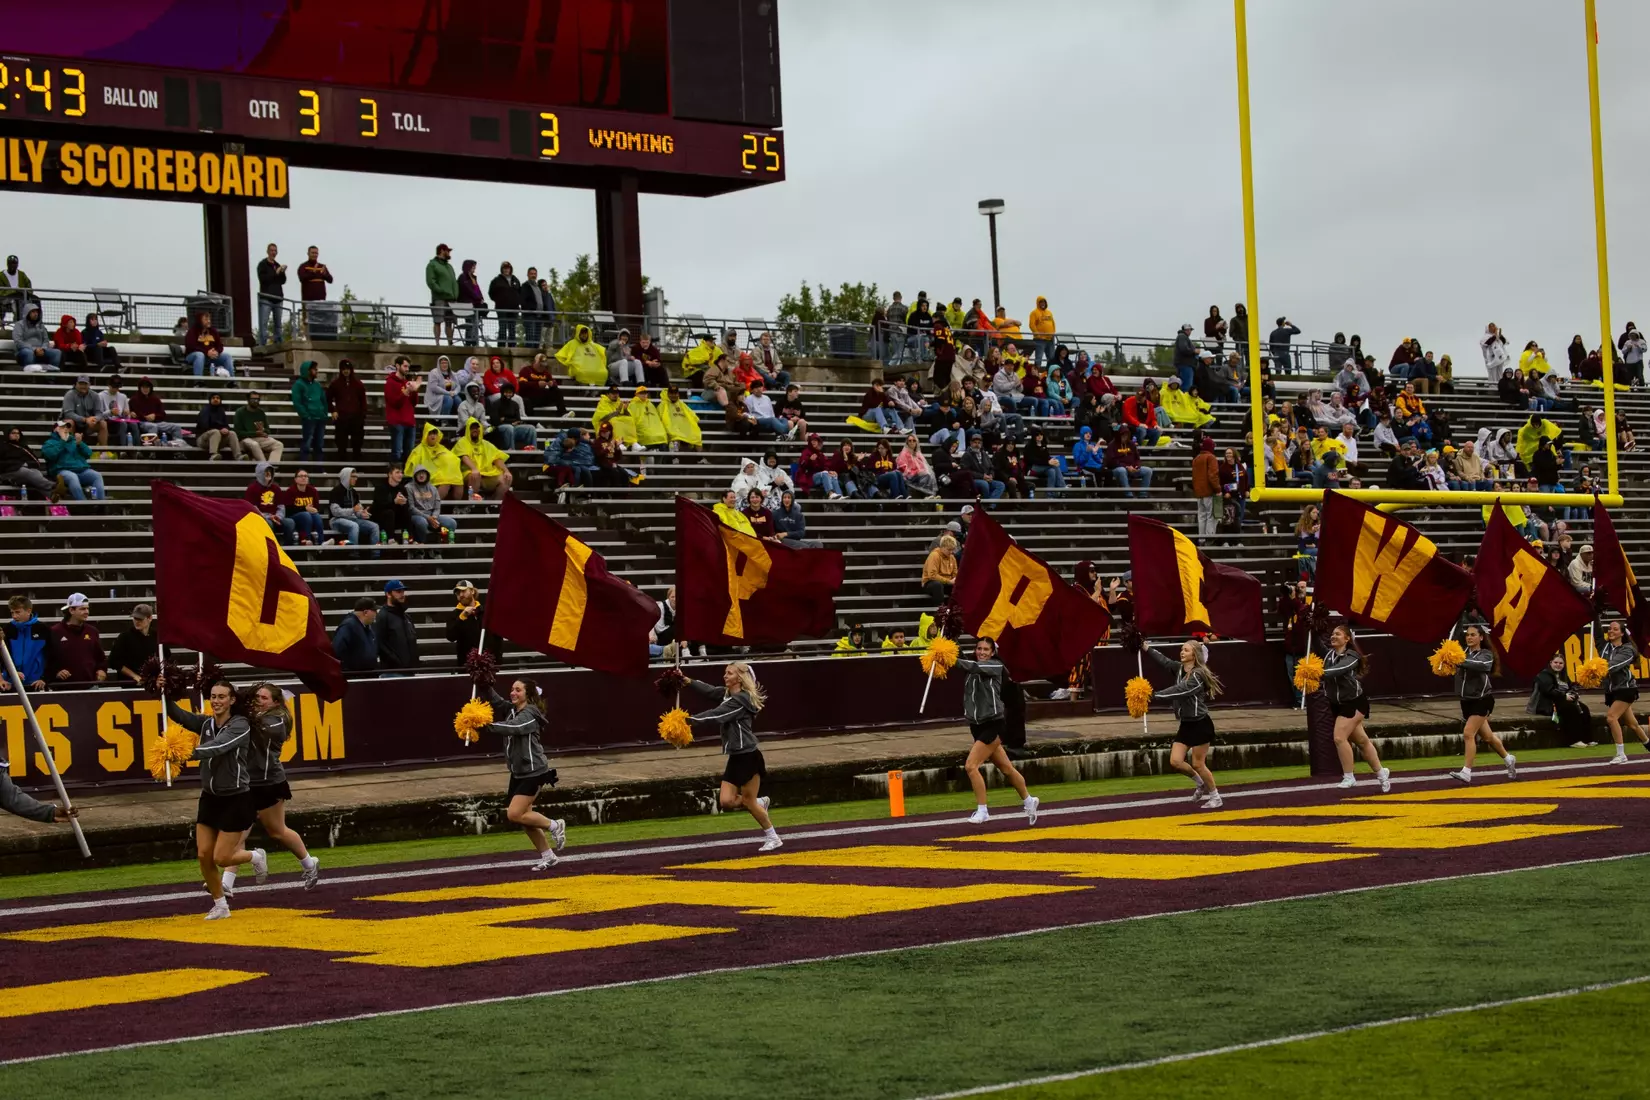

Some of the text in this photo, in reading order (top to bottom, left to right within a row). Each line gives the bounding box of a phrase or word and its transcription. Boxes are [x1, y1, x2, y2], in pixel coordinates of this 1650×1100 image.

[104, 86, 158, 109] BALL ON
[249, 99, 280, 120] QTR
[299, 89, 320, 136] 3
[360, 98, 378, 137] 3
[391, 112, 430, 133] T.O.L.
[540, 112, 560, 157] 3
[589, 128, 674, 154] WYOMING
[742, 134, 780, 171] 25
[61, 142, 287, 198] SCOREBOARD
[1351, 510, 1437, 623] W
